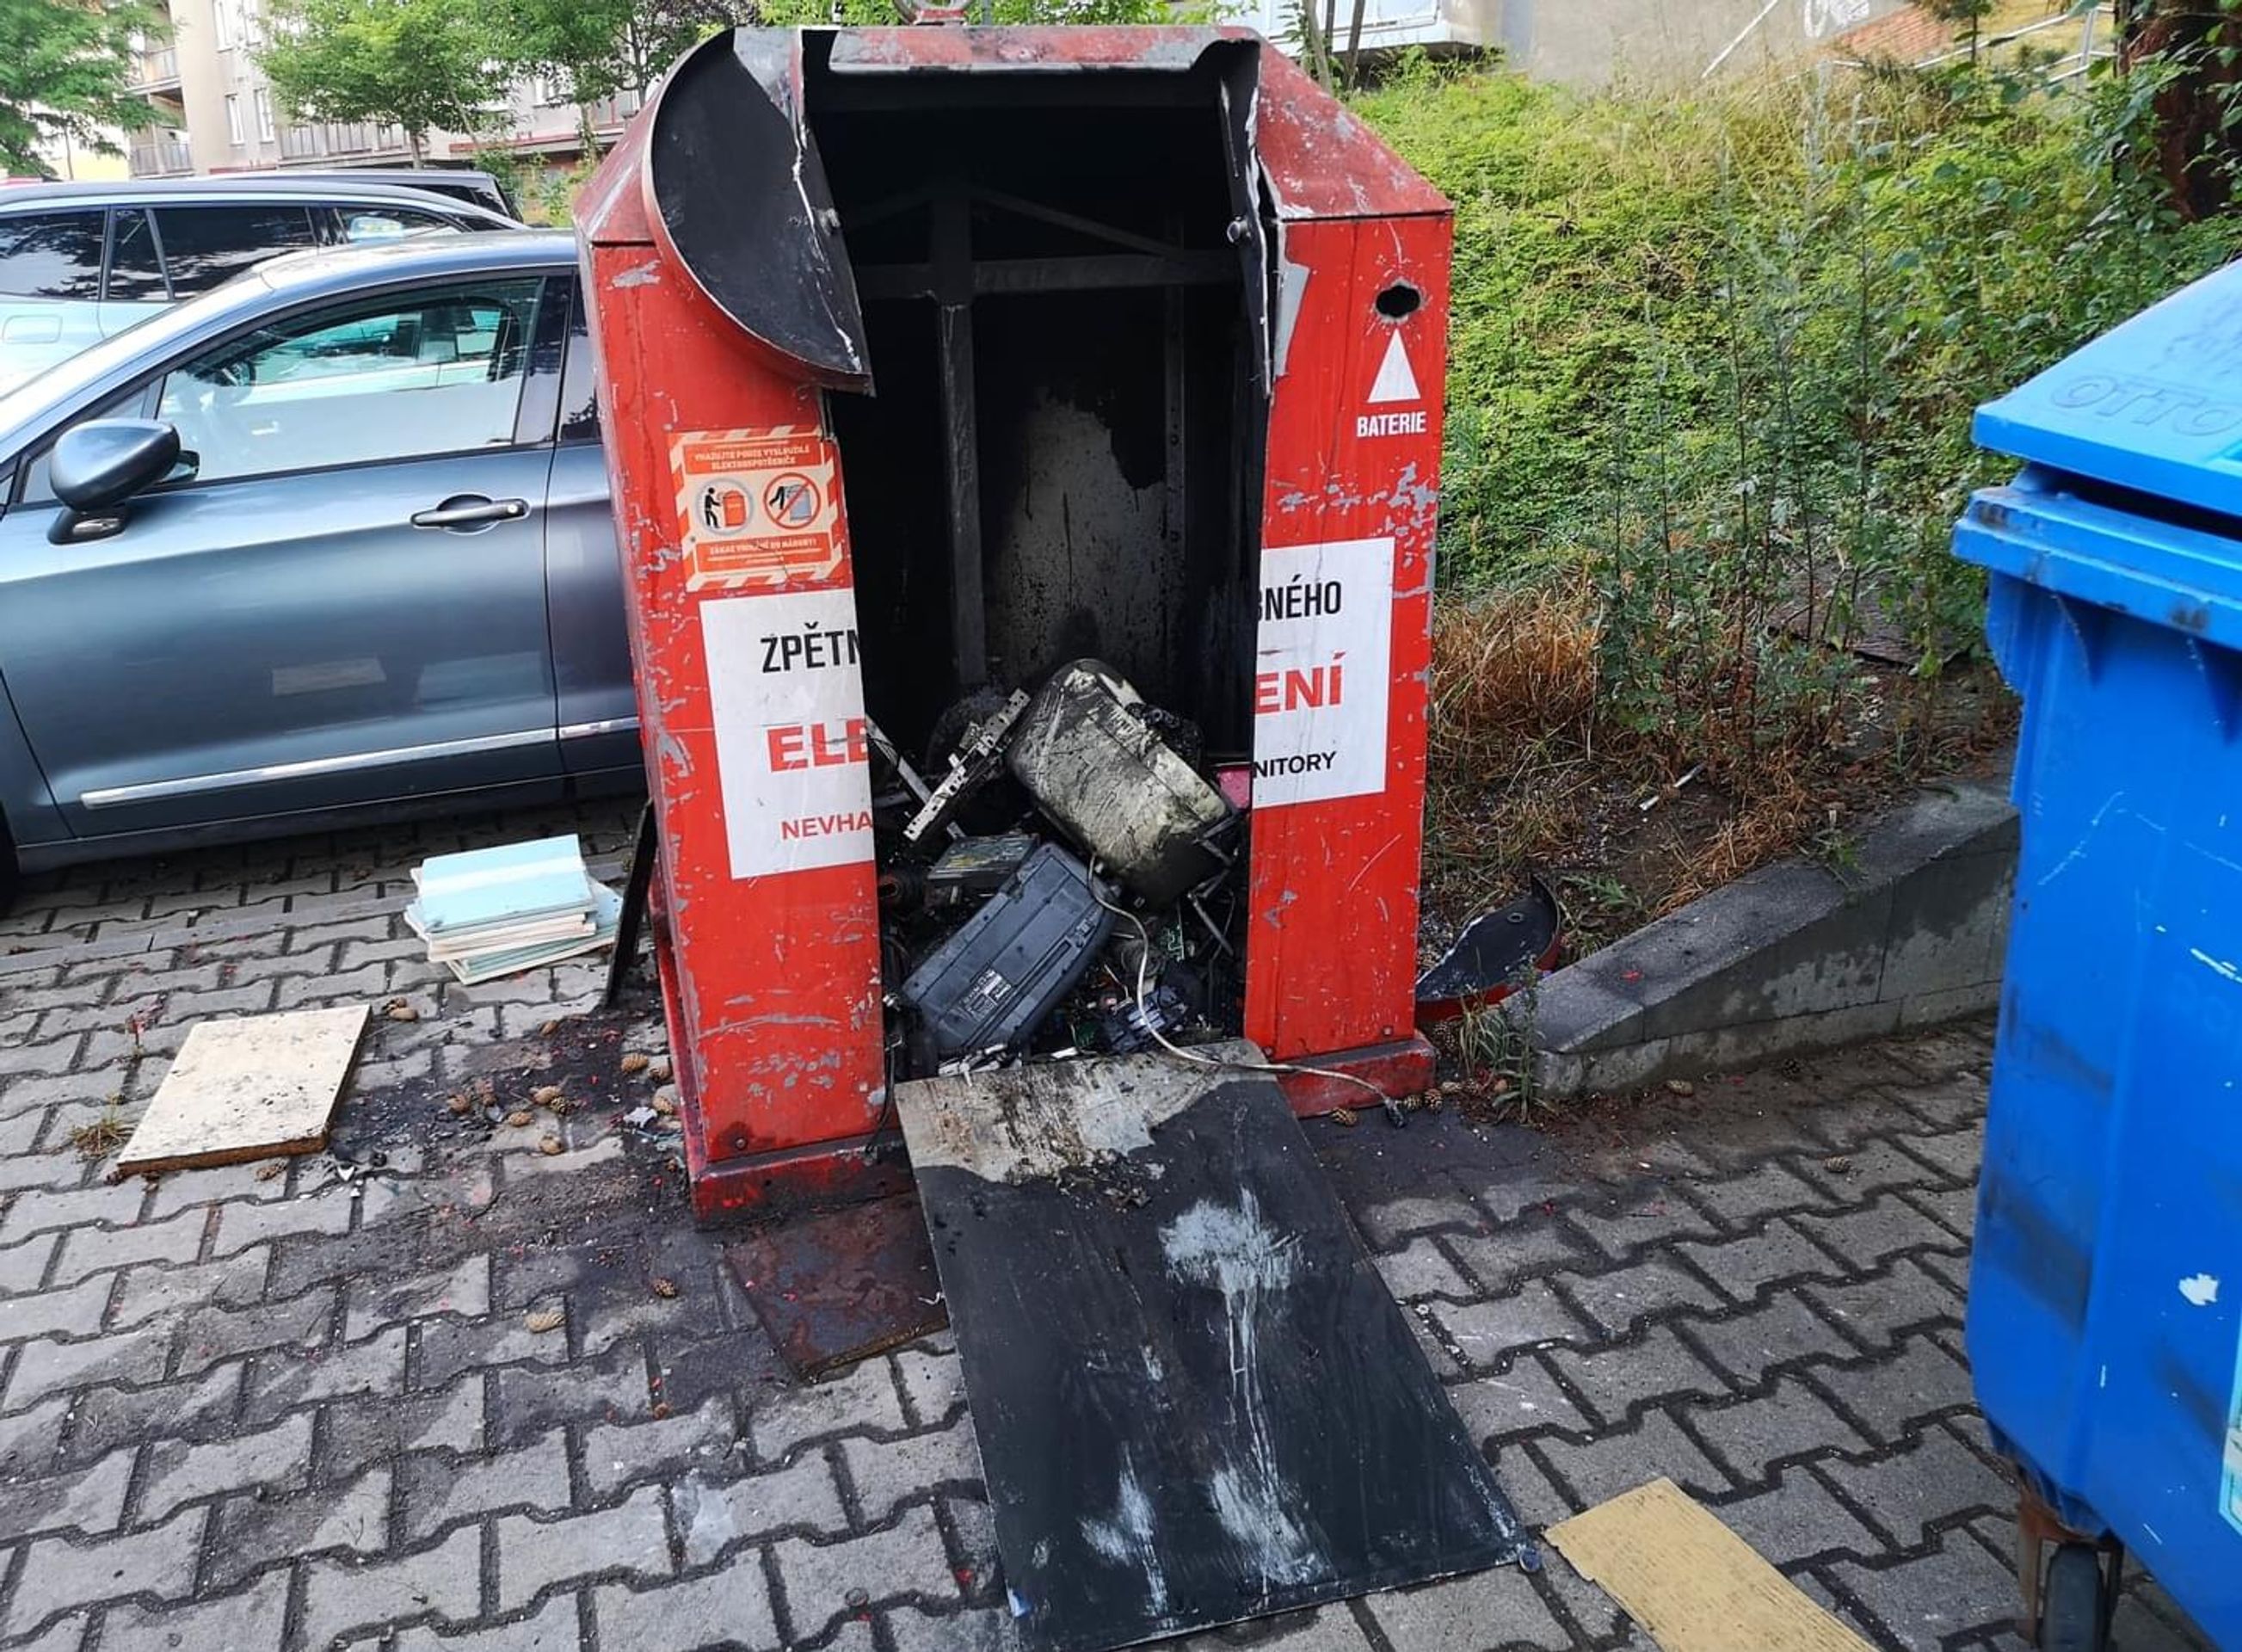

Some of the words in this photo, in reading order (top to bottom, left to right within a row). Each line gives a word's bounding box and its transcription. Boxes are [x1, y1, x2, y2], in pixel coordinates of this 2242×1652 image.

[2051, 373, 2242, 436] OTTO
[1357, 410, 1427, 437] BATERIE
[781, 811, 874, 840] NEVHA
